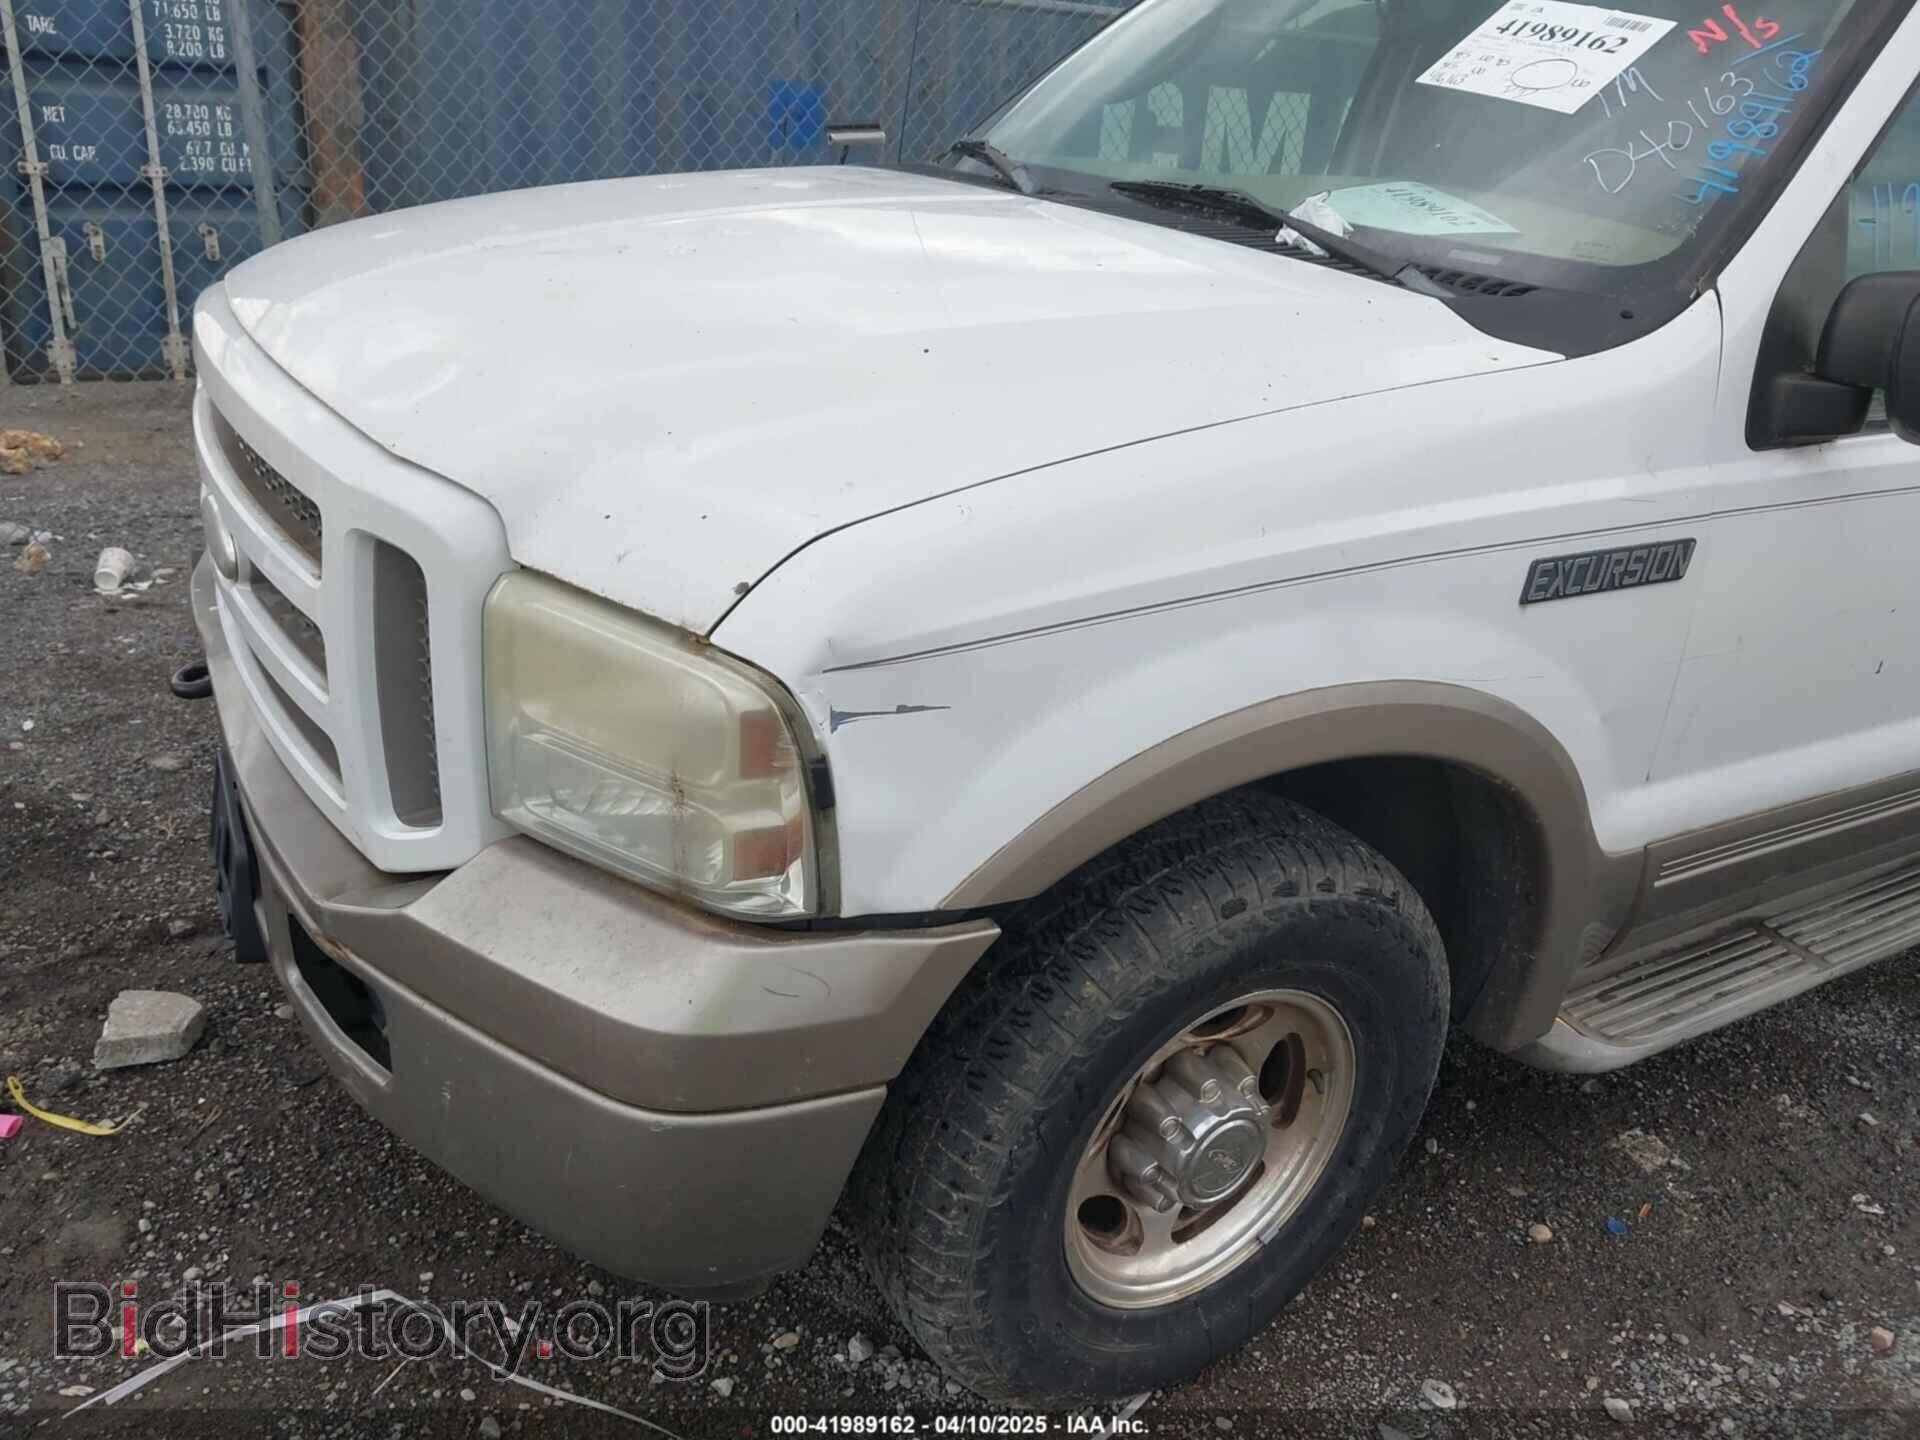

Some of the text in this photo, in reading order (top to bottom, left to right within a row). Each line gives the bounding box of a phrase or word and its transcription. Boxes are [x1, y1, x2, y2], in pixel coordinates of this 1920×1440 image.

[206, 5, 221, 21] LB
[164, 23, 224, 42] 3.720 KG
[1495, 17, 1630, 54] 41989162
[210, 43, 225, 59] LB
[42, 106, 65, 122] NET
[217, 122, 232, 137] LB
[1526, 540, 1696, 602] EXCURSION
